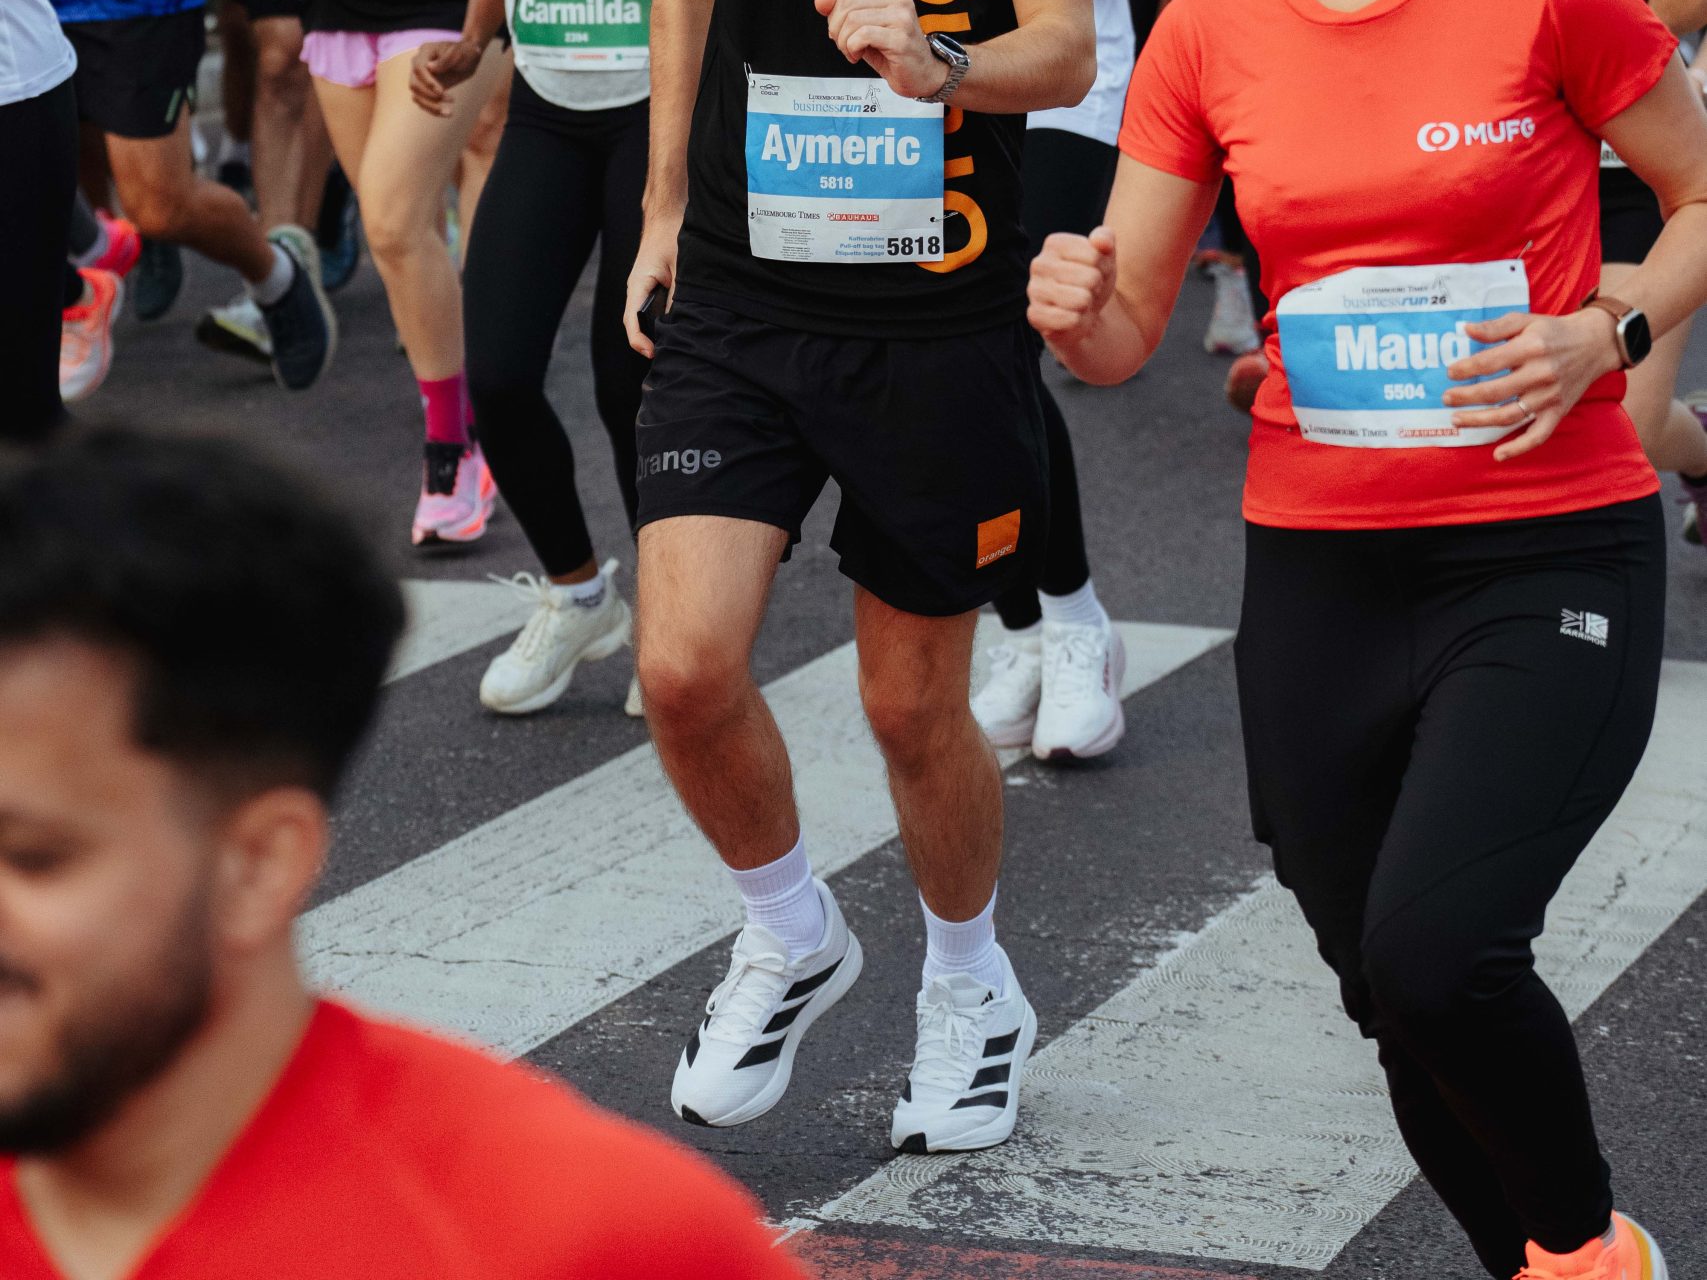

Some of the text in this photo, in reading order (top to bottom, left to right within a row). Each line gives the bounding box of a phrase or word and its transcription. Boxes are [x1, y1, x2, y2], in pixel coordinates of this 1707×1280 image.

[863, 104, 877, 113] 26
[1464, 117, 1536, 146] MUFG
[761, 123, 921, 171] Aymeric
[820, 176, 854, 190] 5818
[834, 213, 880, 222] BAUHAUS
[887, 236, 941, 256] 5818
[1431, 295, 1447, 305] 26
[1334, 321, 1473, 371] Maud
[1383, 383, 1426, 400] 5504
[978, 544, 1012, 565] orange
[1559, 626, 1608, 648] KARRIMOR
